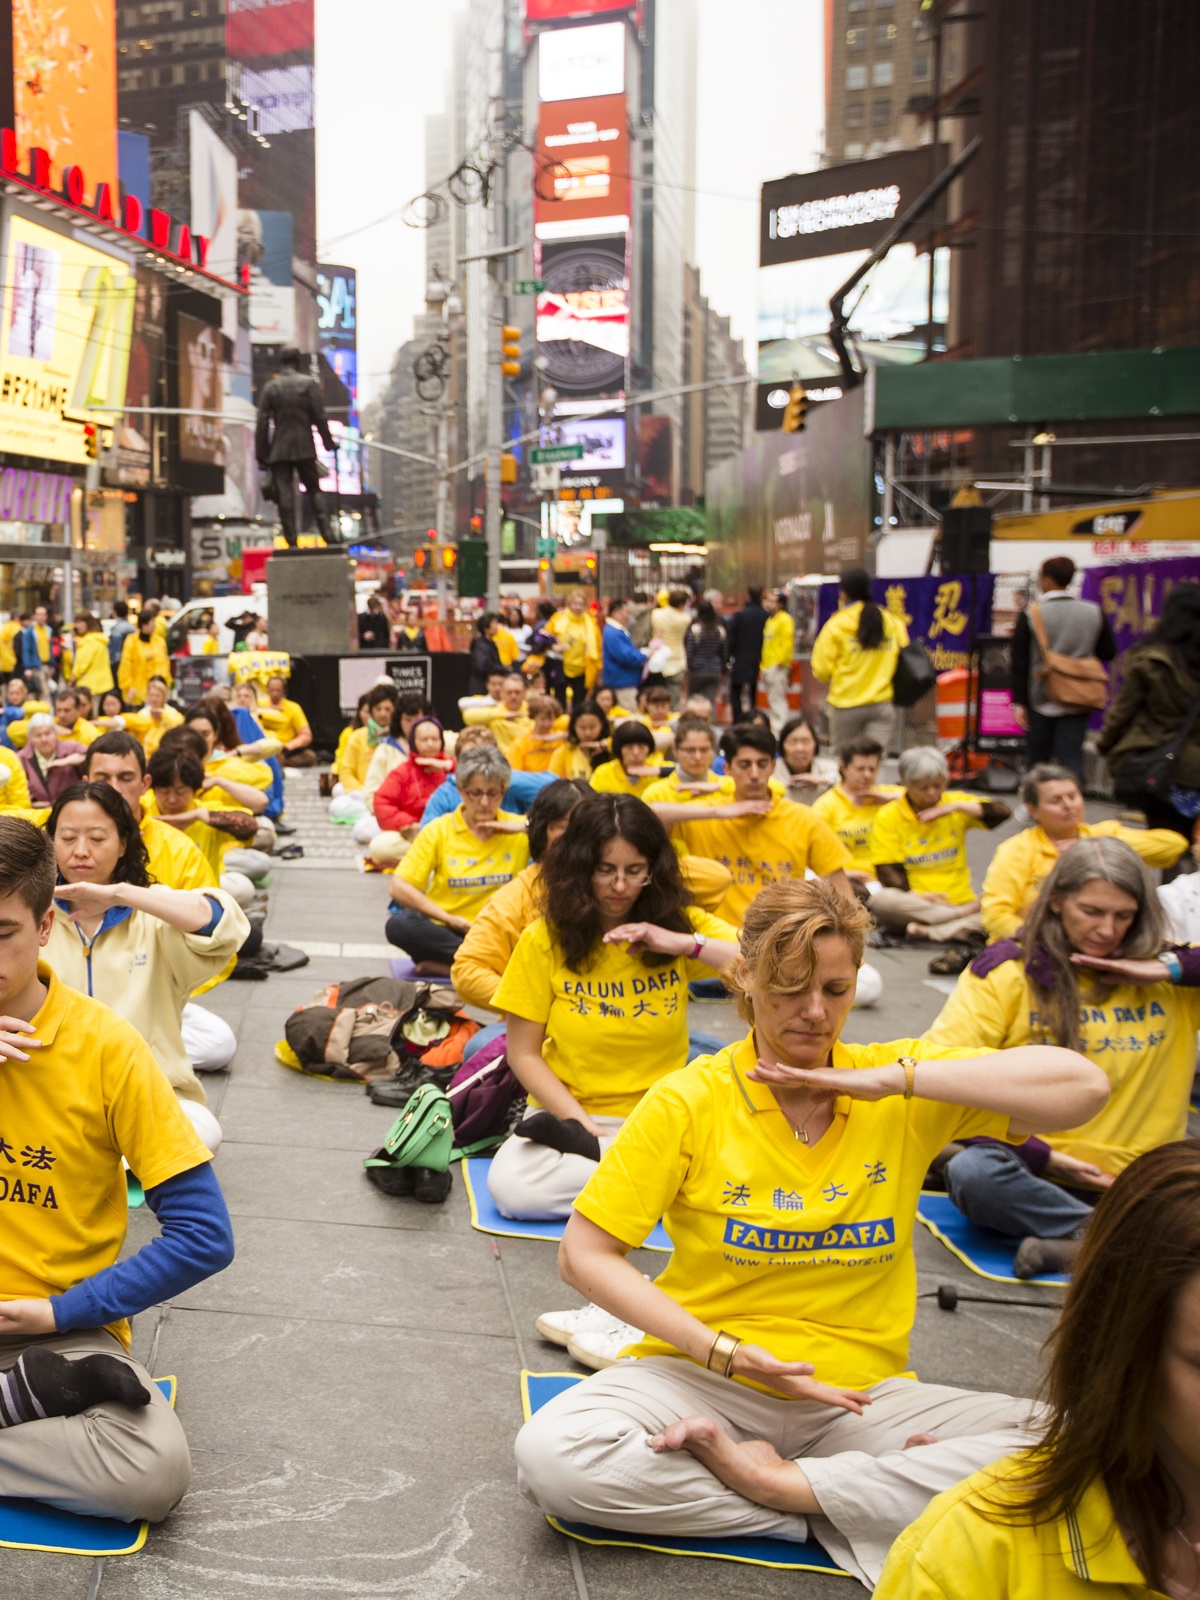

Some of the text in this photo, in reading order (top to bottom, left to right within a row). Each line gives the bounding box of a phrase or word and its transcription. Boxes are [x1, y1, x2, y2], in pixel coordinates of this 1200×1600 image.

[1092, 514, 1127, 535] CAT
[392, 666, 423, 678] TIMES
[564, 969, 681, 998] FALUN DAFA
[1113, 1001, 1165, 1023] DAFA
[722, 1160, 887, 1212] 法輪大法
[730, 1223, 890, 1250] FALUN DAFA
